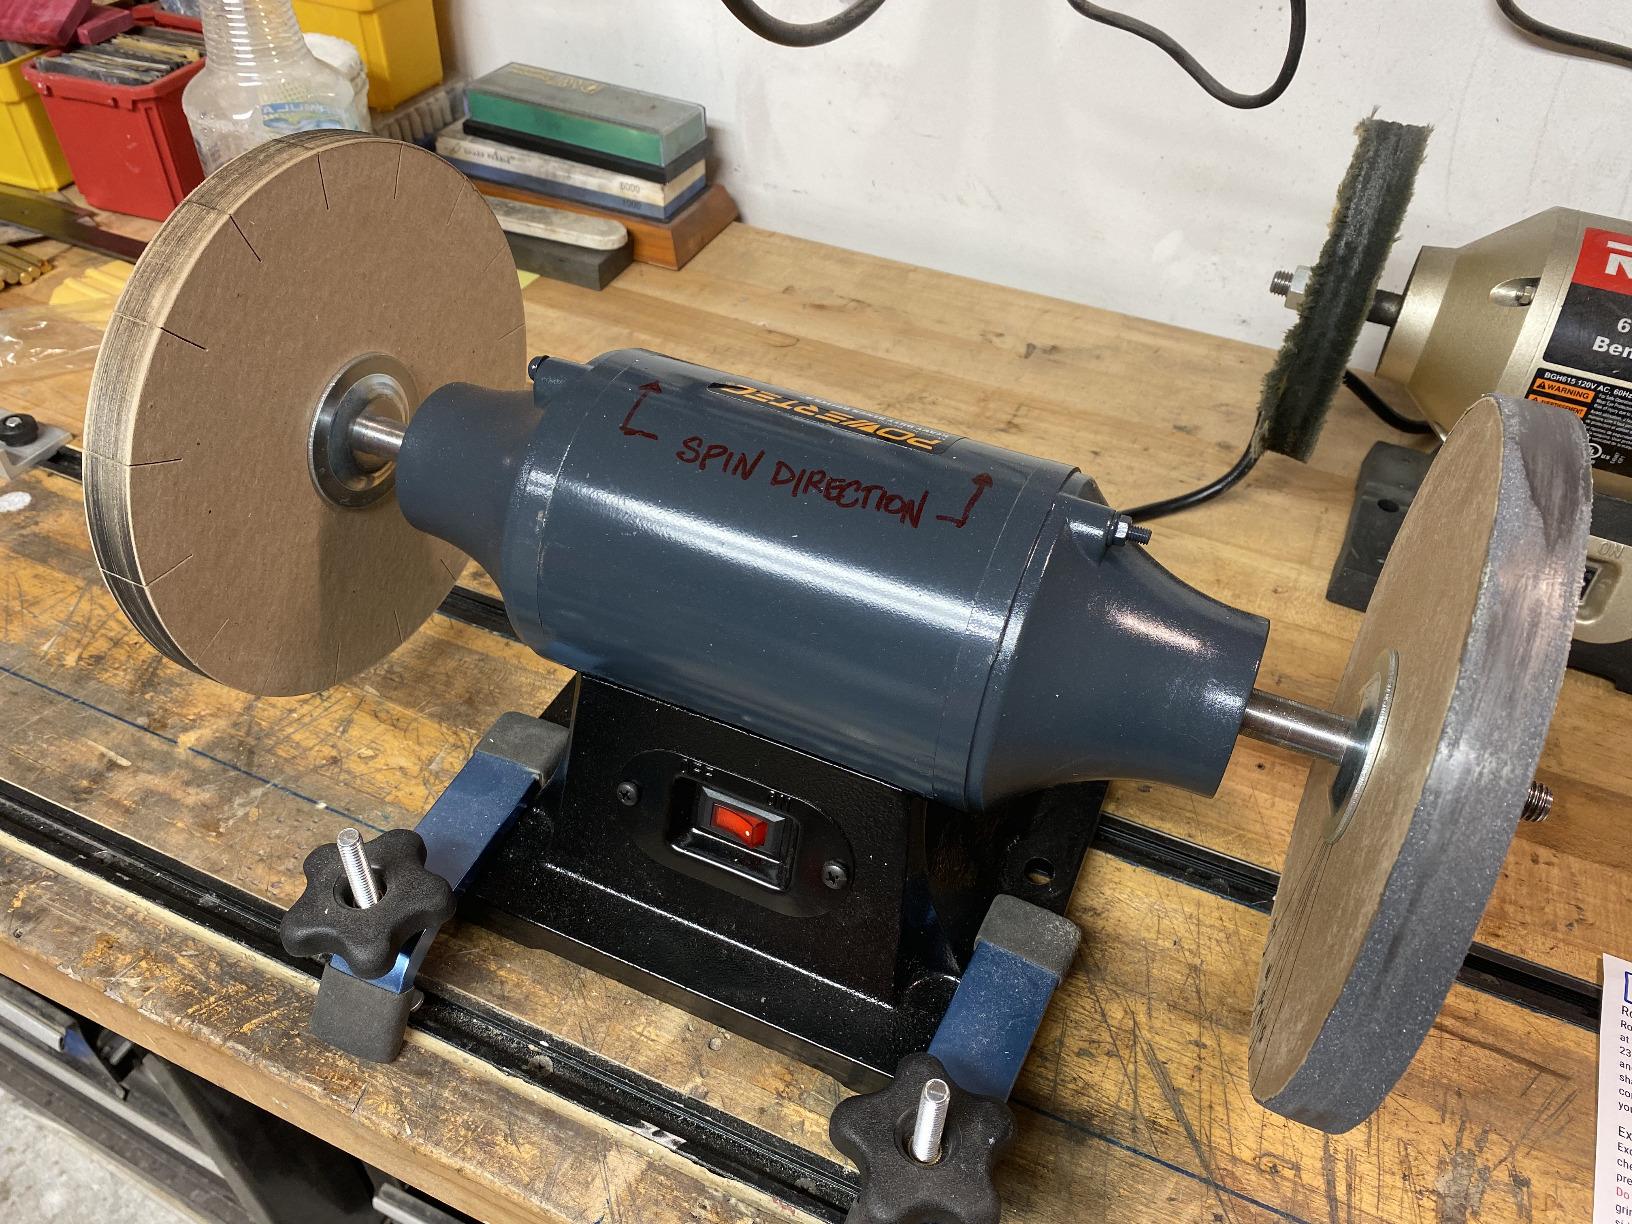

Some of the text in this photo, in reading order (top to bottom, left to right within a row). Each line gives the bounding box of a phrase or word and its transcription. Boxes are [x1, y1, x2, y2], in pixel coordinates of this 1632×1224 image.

[1544, 372, 1576, 385] BGH615
[1578, 380, 1597, 390] 120V
[1547, 383, 1590, 400] WARNING
[721, 384, 943, 450] POWERTEC
[676, 435, 929, 529] SPIN DIRECTION
[1599, 541, 1625, 560] ON
[1619, 1034, 1630, 1044] at
[1619, 1046, 1632, 1058] 23
[1619, 1061, 1632, 1071] an
[1619, 1074, 1632, 1085] sh
[1618, 1088, 1632, 1099] co
[1616, 1173, 1632, 1186] pre
[1616, 1186, 1630, 1200] Do
